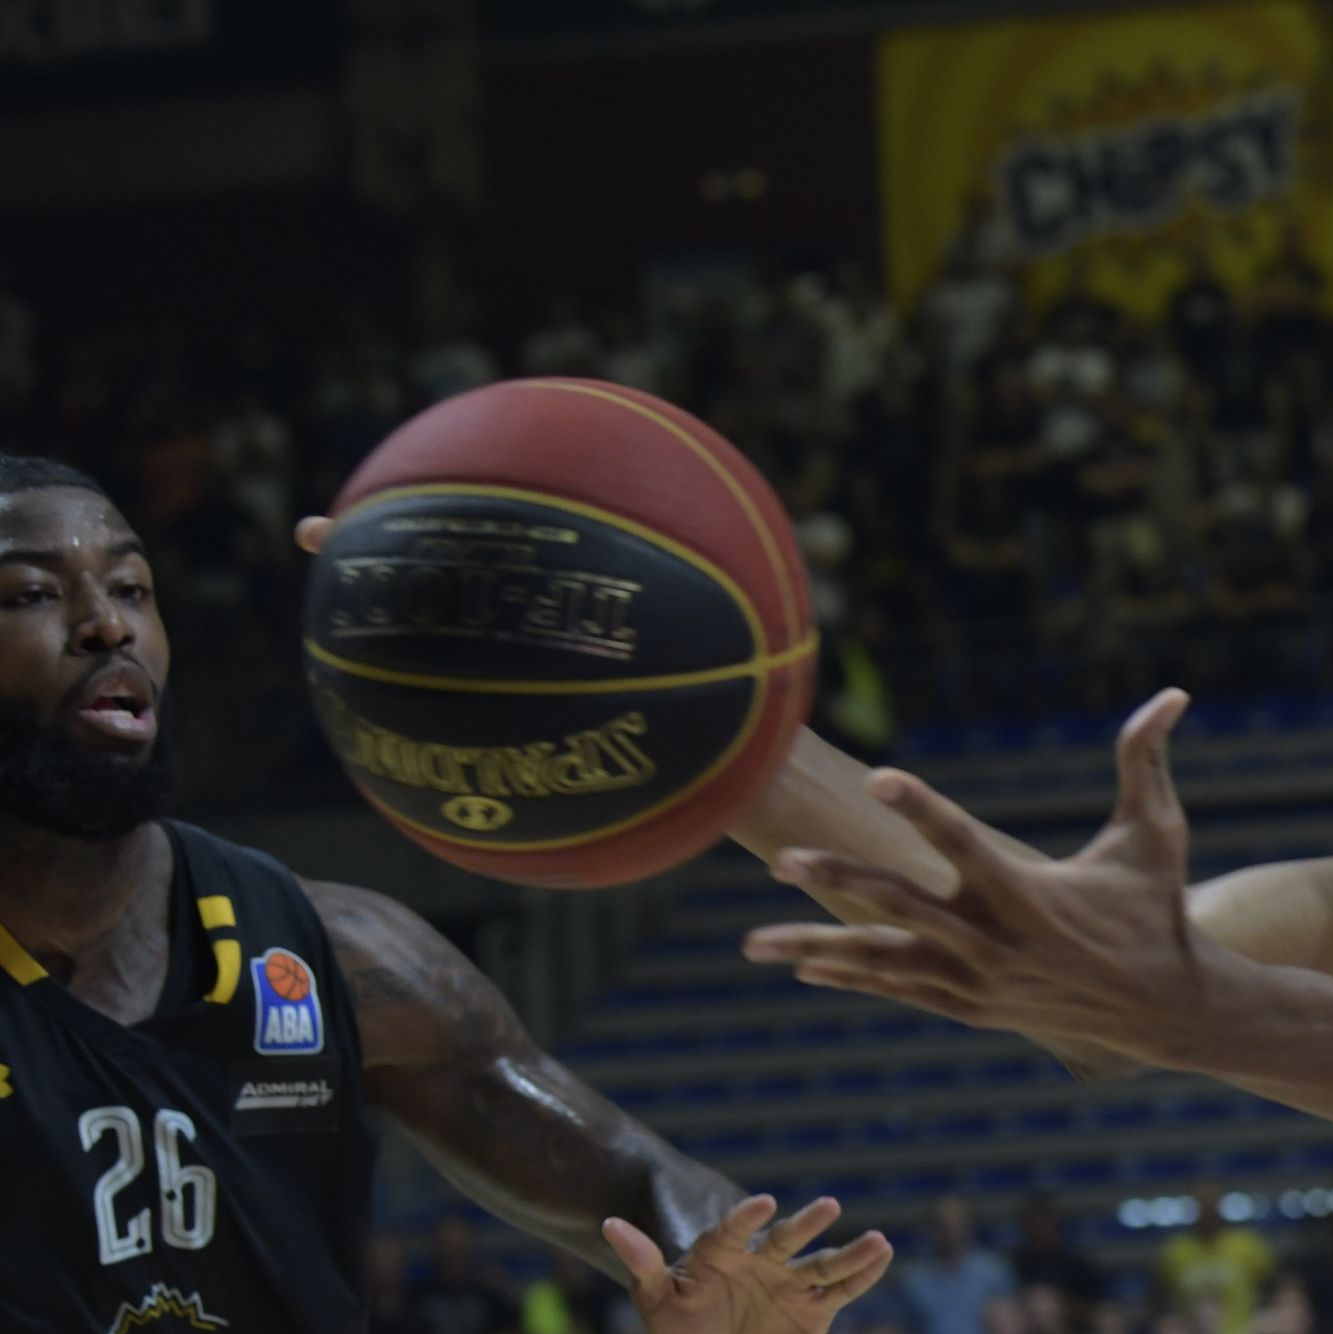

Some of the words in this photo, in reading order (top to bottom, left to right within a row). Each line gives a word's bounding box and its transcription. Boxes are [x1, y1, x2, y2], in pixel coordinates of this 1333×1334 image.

[264, 1005, 314, 1046] ABA
[239, 1080, 330, 1097] ADMIRAL
[77, 1105, 218, 1267] 26
